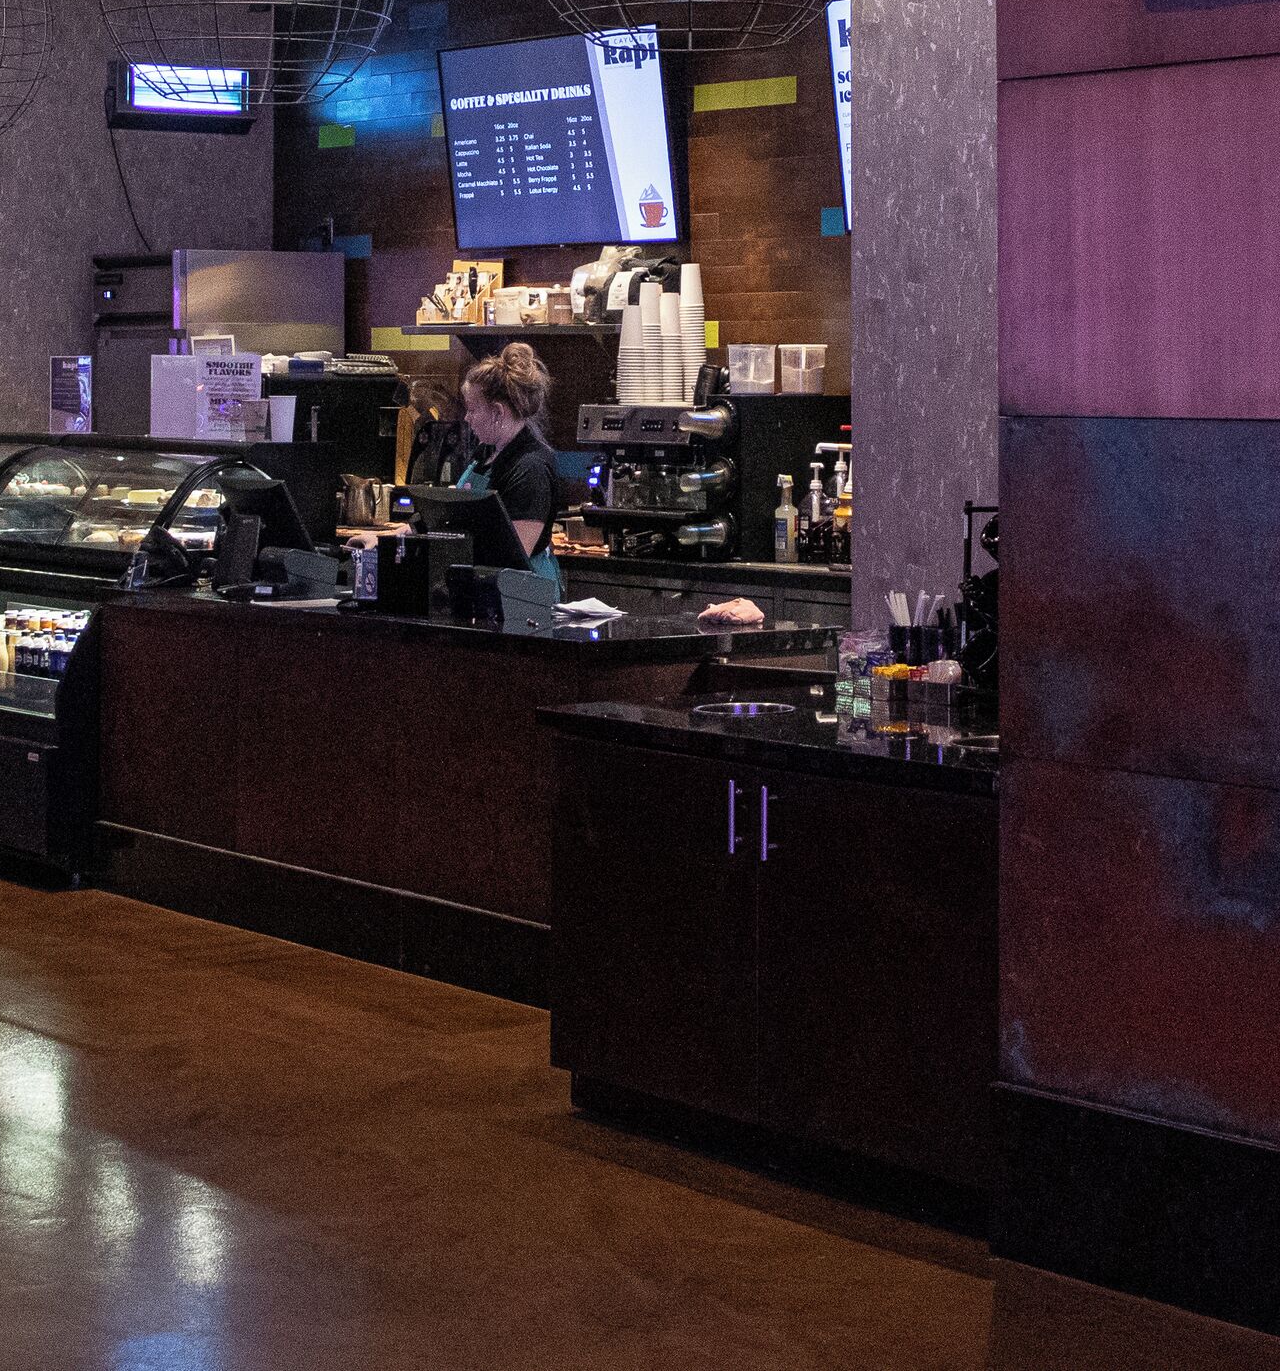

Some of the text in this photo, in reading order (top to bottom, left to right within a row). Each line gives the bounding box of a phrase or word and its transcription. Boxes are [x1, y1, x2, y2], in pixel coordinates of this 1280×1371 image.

[601, 37, 657, 70] kapi
[451, 96, 486, 110] COFFEE
[496, 88, 549, 105] SPECIALTY
[551, 84, 591, 100] DRINKS
